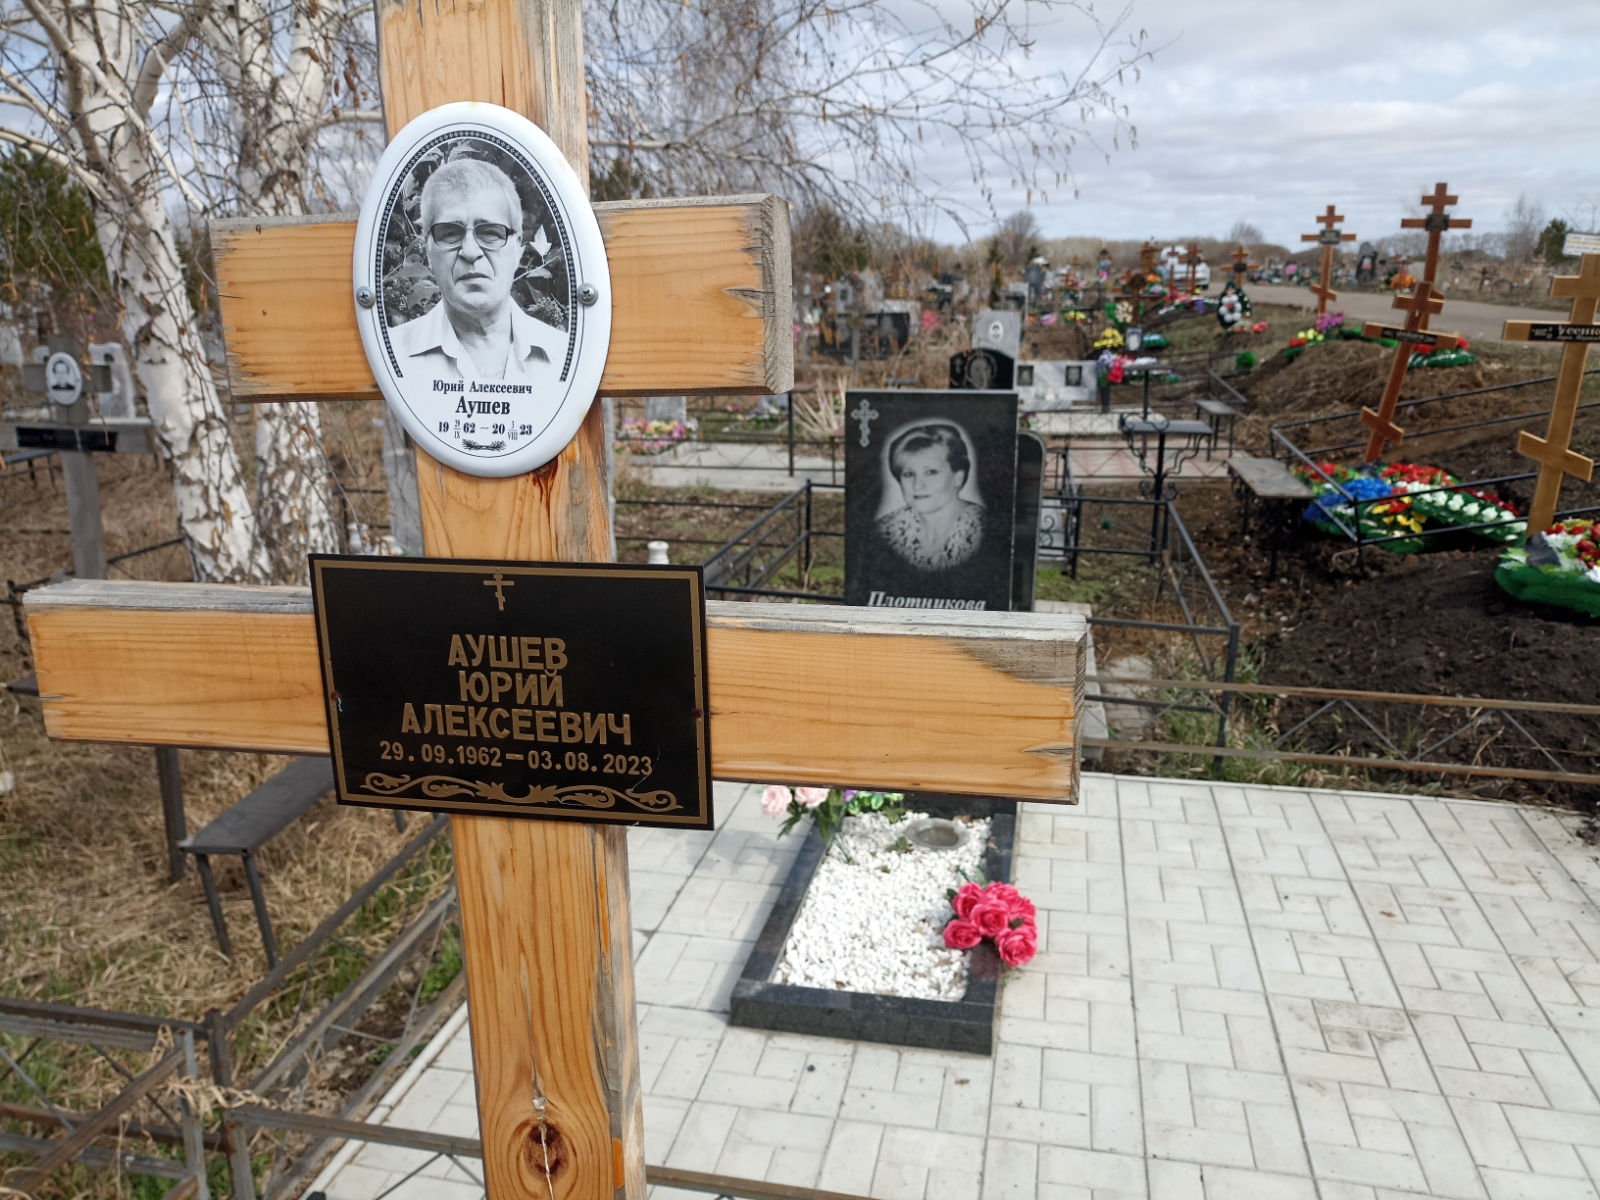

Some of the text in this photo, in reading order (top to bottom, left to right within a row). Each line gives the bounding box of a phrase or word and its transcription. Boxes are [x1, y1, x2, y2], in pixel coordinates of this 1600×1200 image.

[433, 379, 532, 394] Юрий Алексеевич
[455, 395, 511, 418] Аушев
[438, 421, 449, 433] 19
[463, 422, 476, 434] 62
[492, 423, 505, 435] 20
[519, 424, 533, 436] 23
[867, 590, 987, 611] Плотникова
[447, 633, 568, 671] АУШЕВ
[458, 669, 564, 708] ЮРИЙ
[401, 702, 632, 746] АЛЕКСЕЕВИЧ
